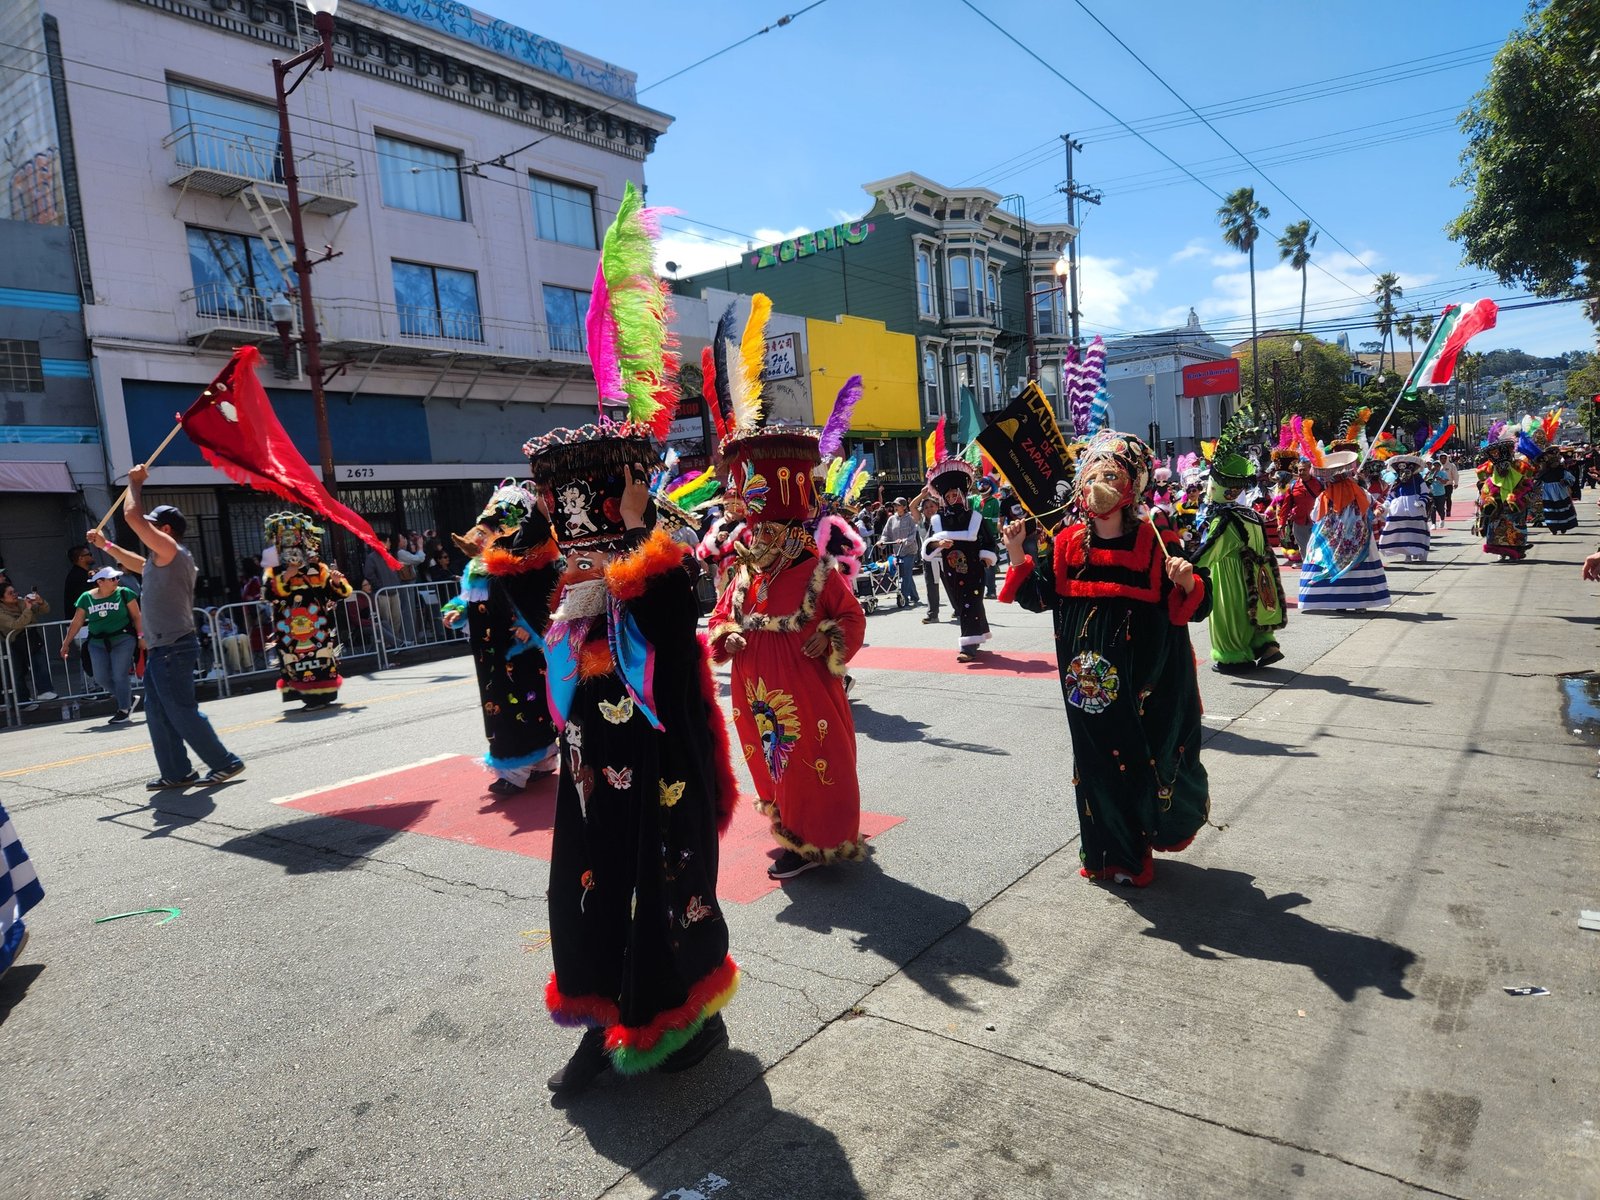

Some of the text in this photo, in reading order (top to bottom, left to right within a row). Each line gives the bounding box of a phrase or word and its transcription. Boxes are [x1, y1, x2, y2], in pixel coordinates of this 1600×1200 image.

[1040, 440, 1054, 457] DE
[1021, 437, 1053, 480] ZAPATA
[346, 468, 375, 478] 2673
[1022, 471, 1039, 495] LIBERTAD
[88, 601, 120, 614] MEXICO
